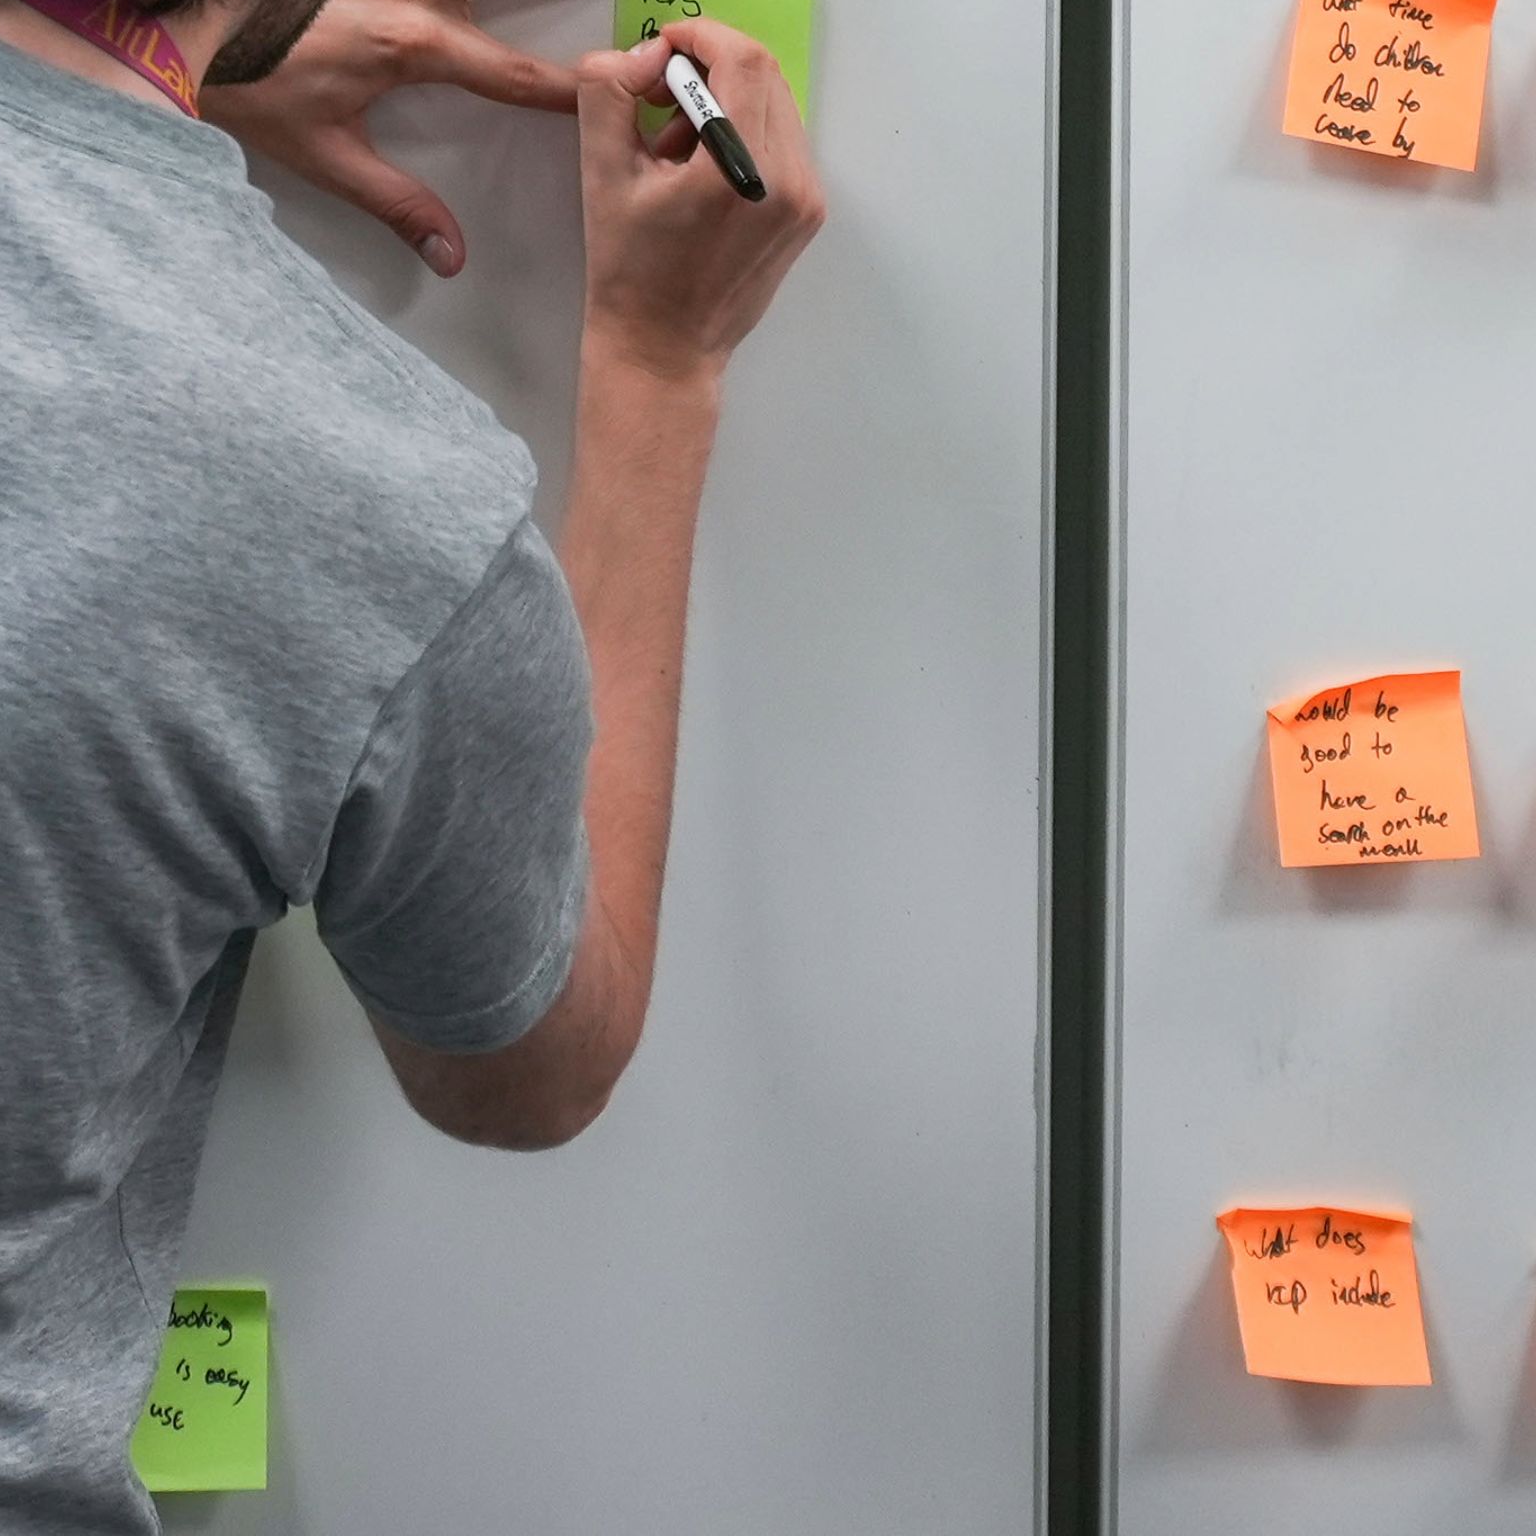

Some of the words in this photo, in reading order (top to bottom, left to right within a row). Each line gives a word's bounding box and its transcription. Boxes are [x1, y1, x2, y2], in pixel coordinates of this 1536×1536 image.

[1329, 22, 1356, 63] do
[1398, 90, 1420, 113] to
[1393, 117, 1415, 158] by
[1375, 691, 1399, 722] be
[1301, 732, 1351, 773] good
[1371, 732, 1392, 758] to
[1320, 779, 1376, 810] have
[1395, 787, 1415, 803] a
[1383, 821, 1411, 836] on
[1415, 806, 1448, 827] the
[1315, 1217, 1366, 1256] does
